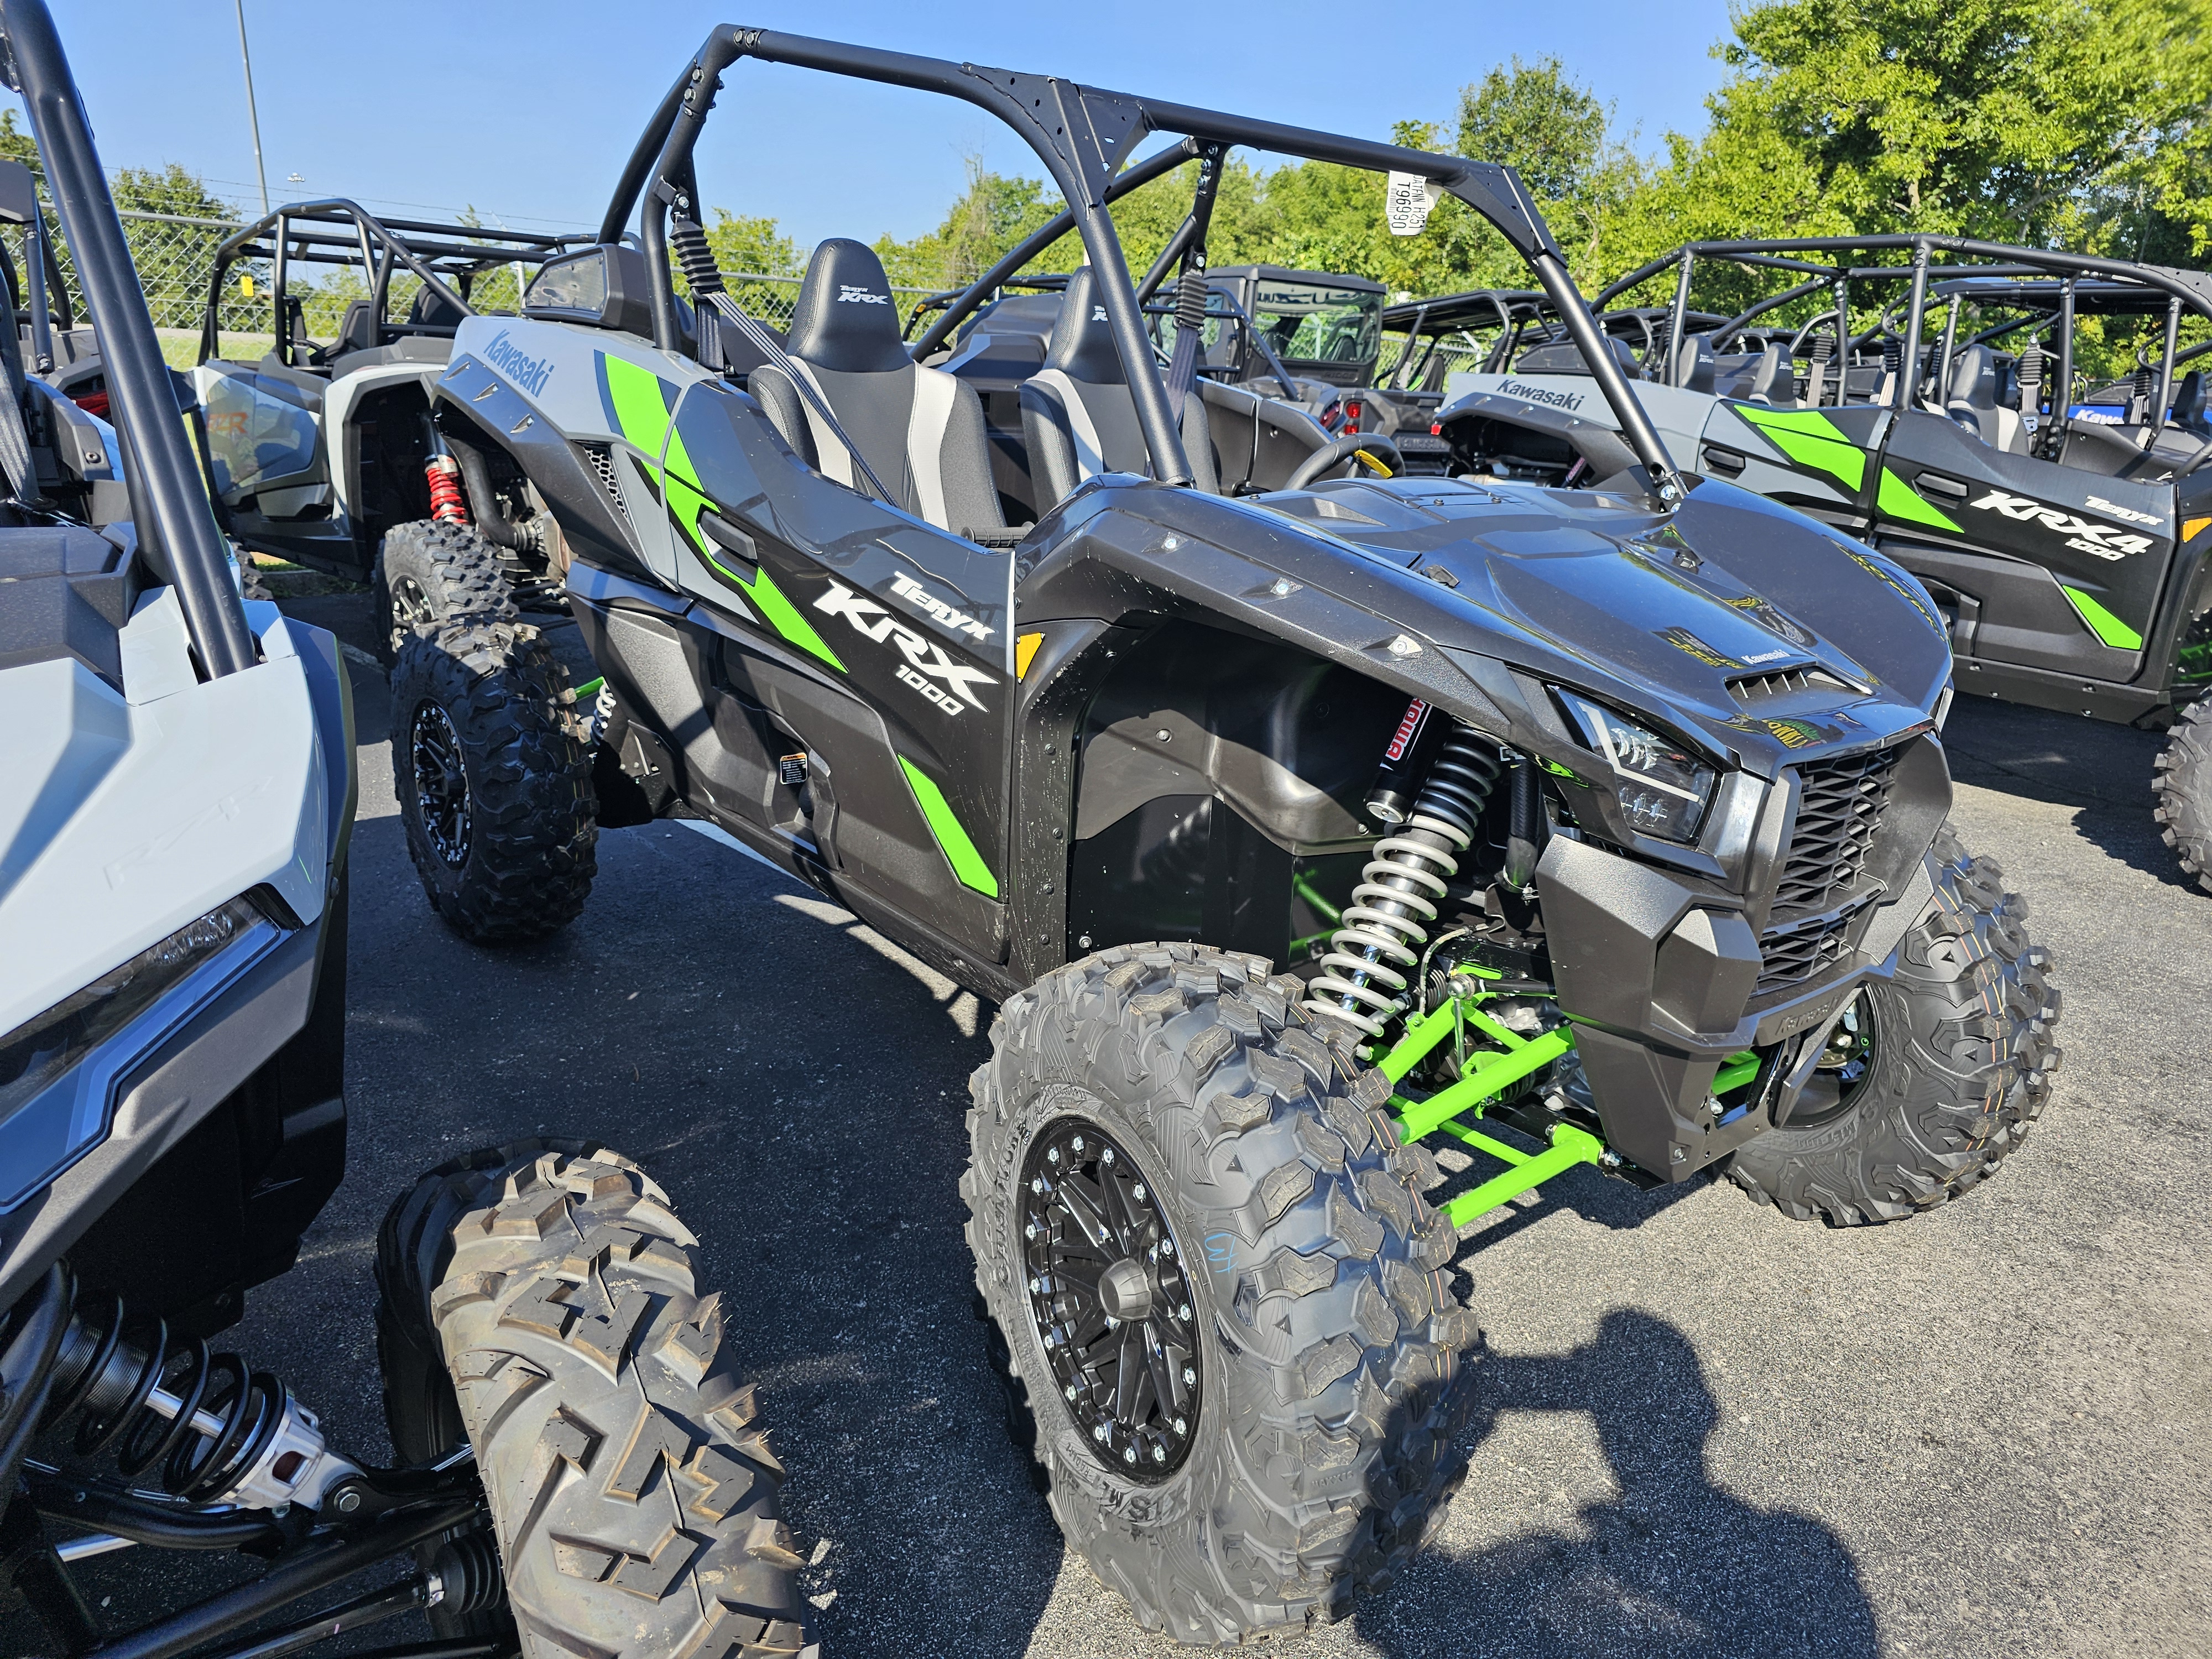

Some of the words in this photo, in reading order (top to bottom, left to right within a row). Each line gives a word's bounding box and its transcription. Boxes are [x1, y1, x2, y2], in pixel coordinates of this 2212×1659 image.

[1391, 182, 1412, 228] T96990
[837, 291, 888, 305] KRX
[483, 328, 555, 398] Kawasaki
[1496, 379, 1585, 411] Kawasaki
[1970, 489, 2153, 554] KRX4
[2065, 538, 2126, 561] 1000
[812, 577, 1001, 713] KRX
[1741, 649, 1791, 664] Kawasaki
[895, 664, 966, 716] 1000
